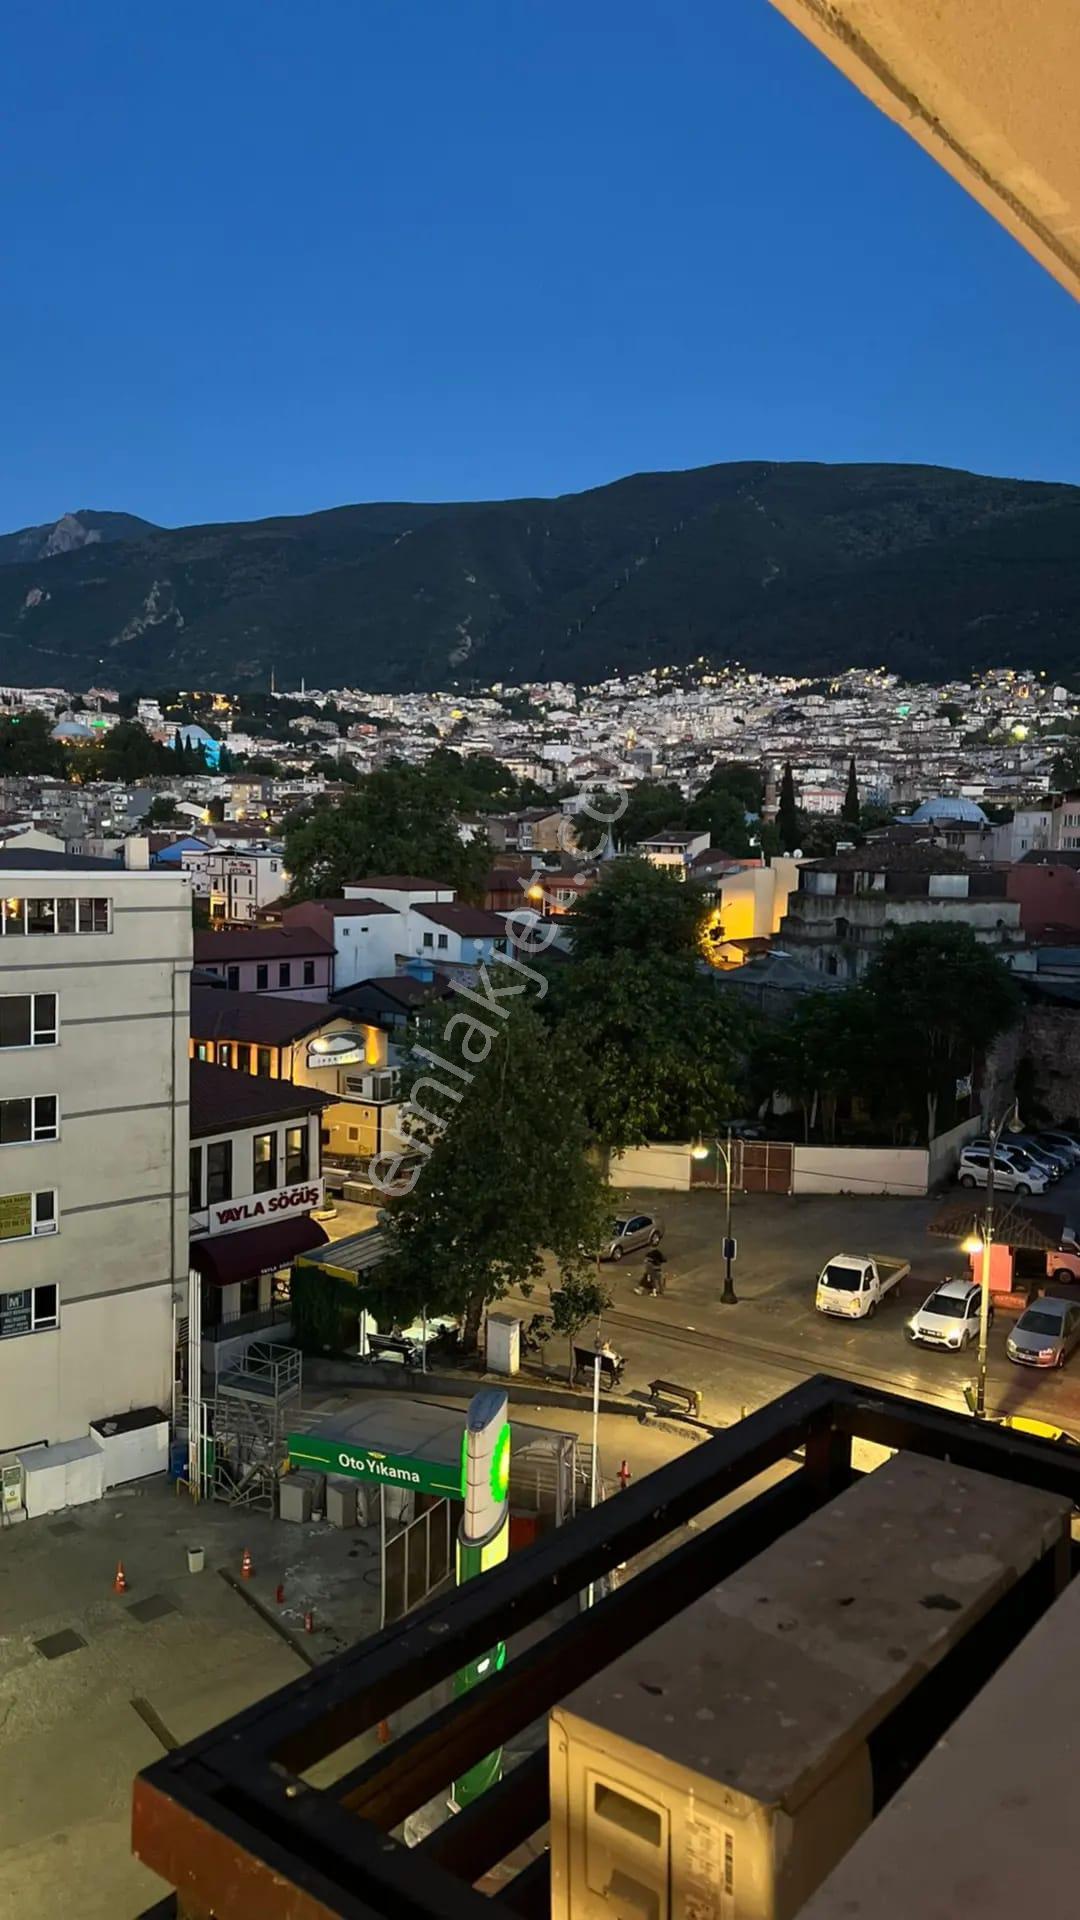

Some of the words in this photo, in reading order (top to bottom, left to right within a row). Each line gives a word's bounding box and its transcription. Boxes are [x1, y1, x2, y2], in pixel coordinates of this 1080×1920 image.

[216, 1201, 265, 1225] YAYLA
[268, 1186, 319, 1212] SÖĞÜŞ
[338, 1453, 365, 1471] Oto
[366, 1459, 420, 1483] Yıkama
